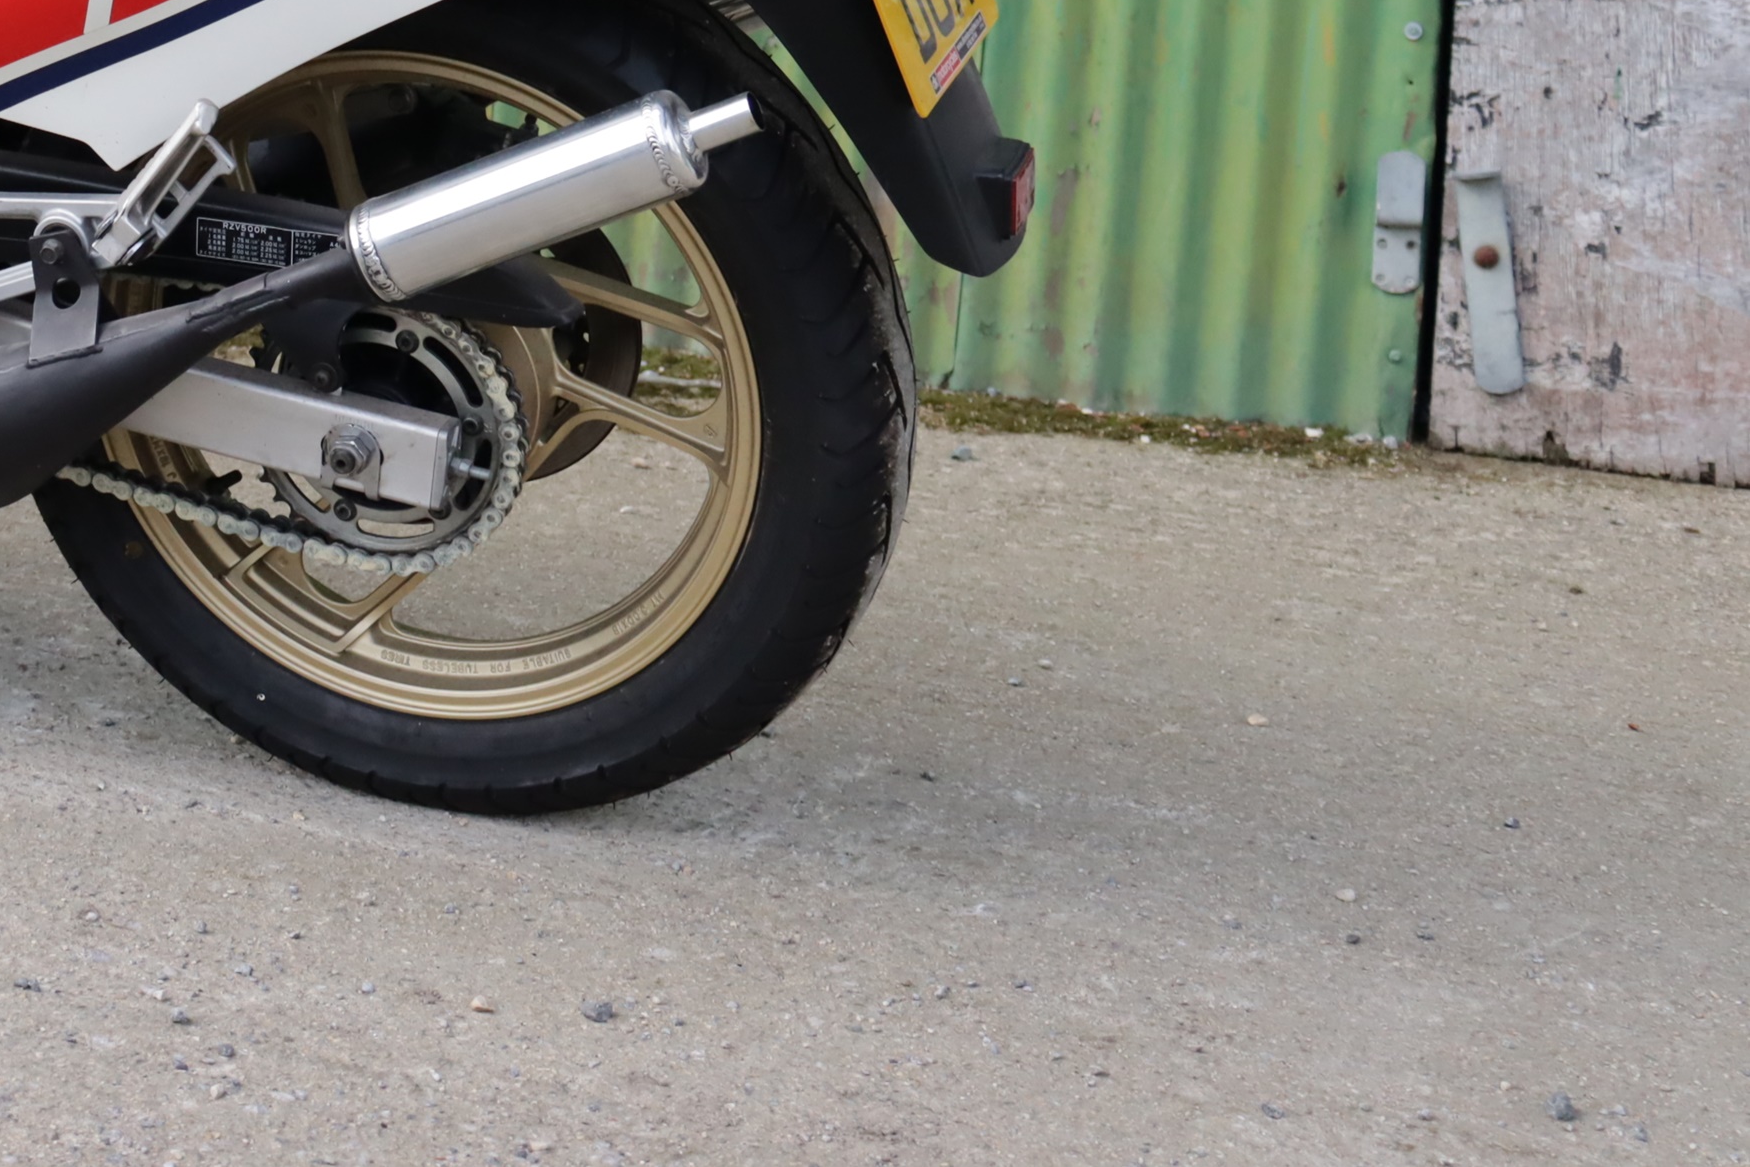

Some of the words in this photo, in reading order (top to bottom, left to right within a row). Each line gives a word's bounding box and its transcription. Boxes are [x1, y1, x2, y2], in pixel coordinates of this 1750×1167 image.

[222, 221, 267, 235] RZV500R
[380, 648, 411, 667] TIRES
[522, 647, 572, 670] SUITABLE
[421, 658, 479, 675] TUBELESS
[490, 661, 511, 674] FOR
